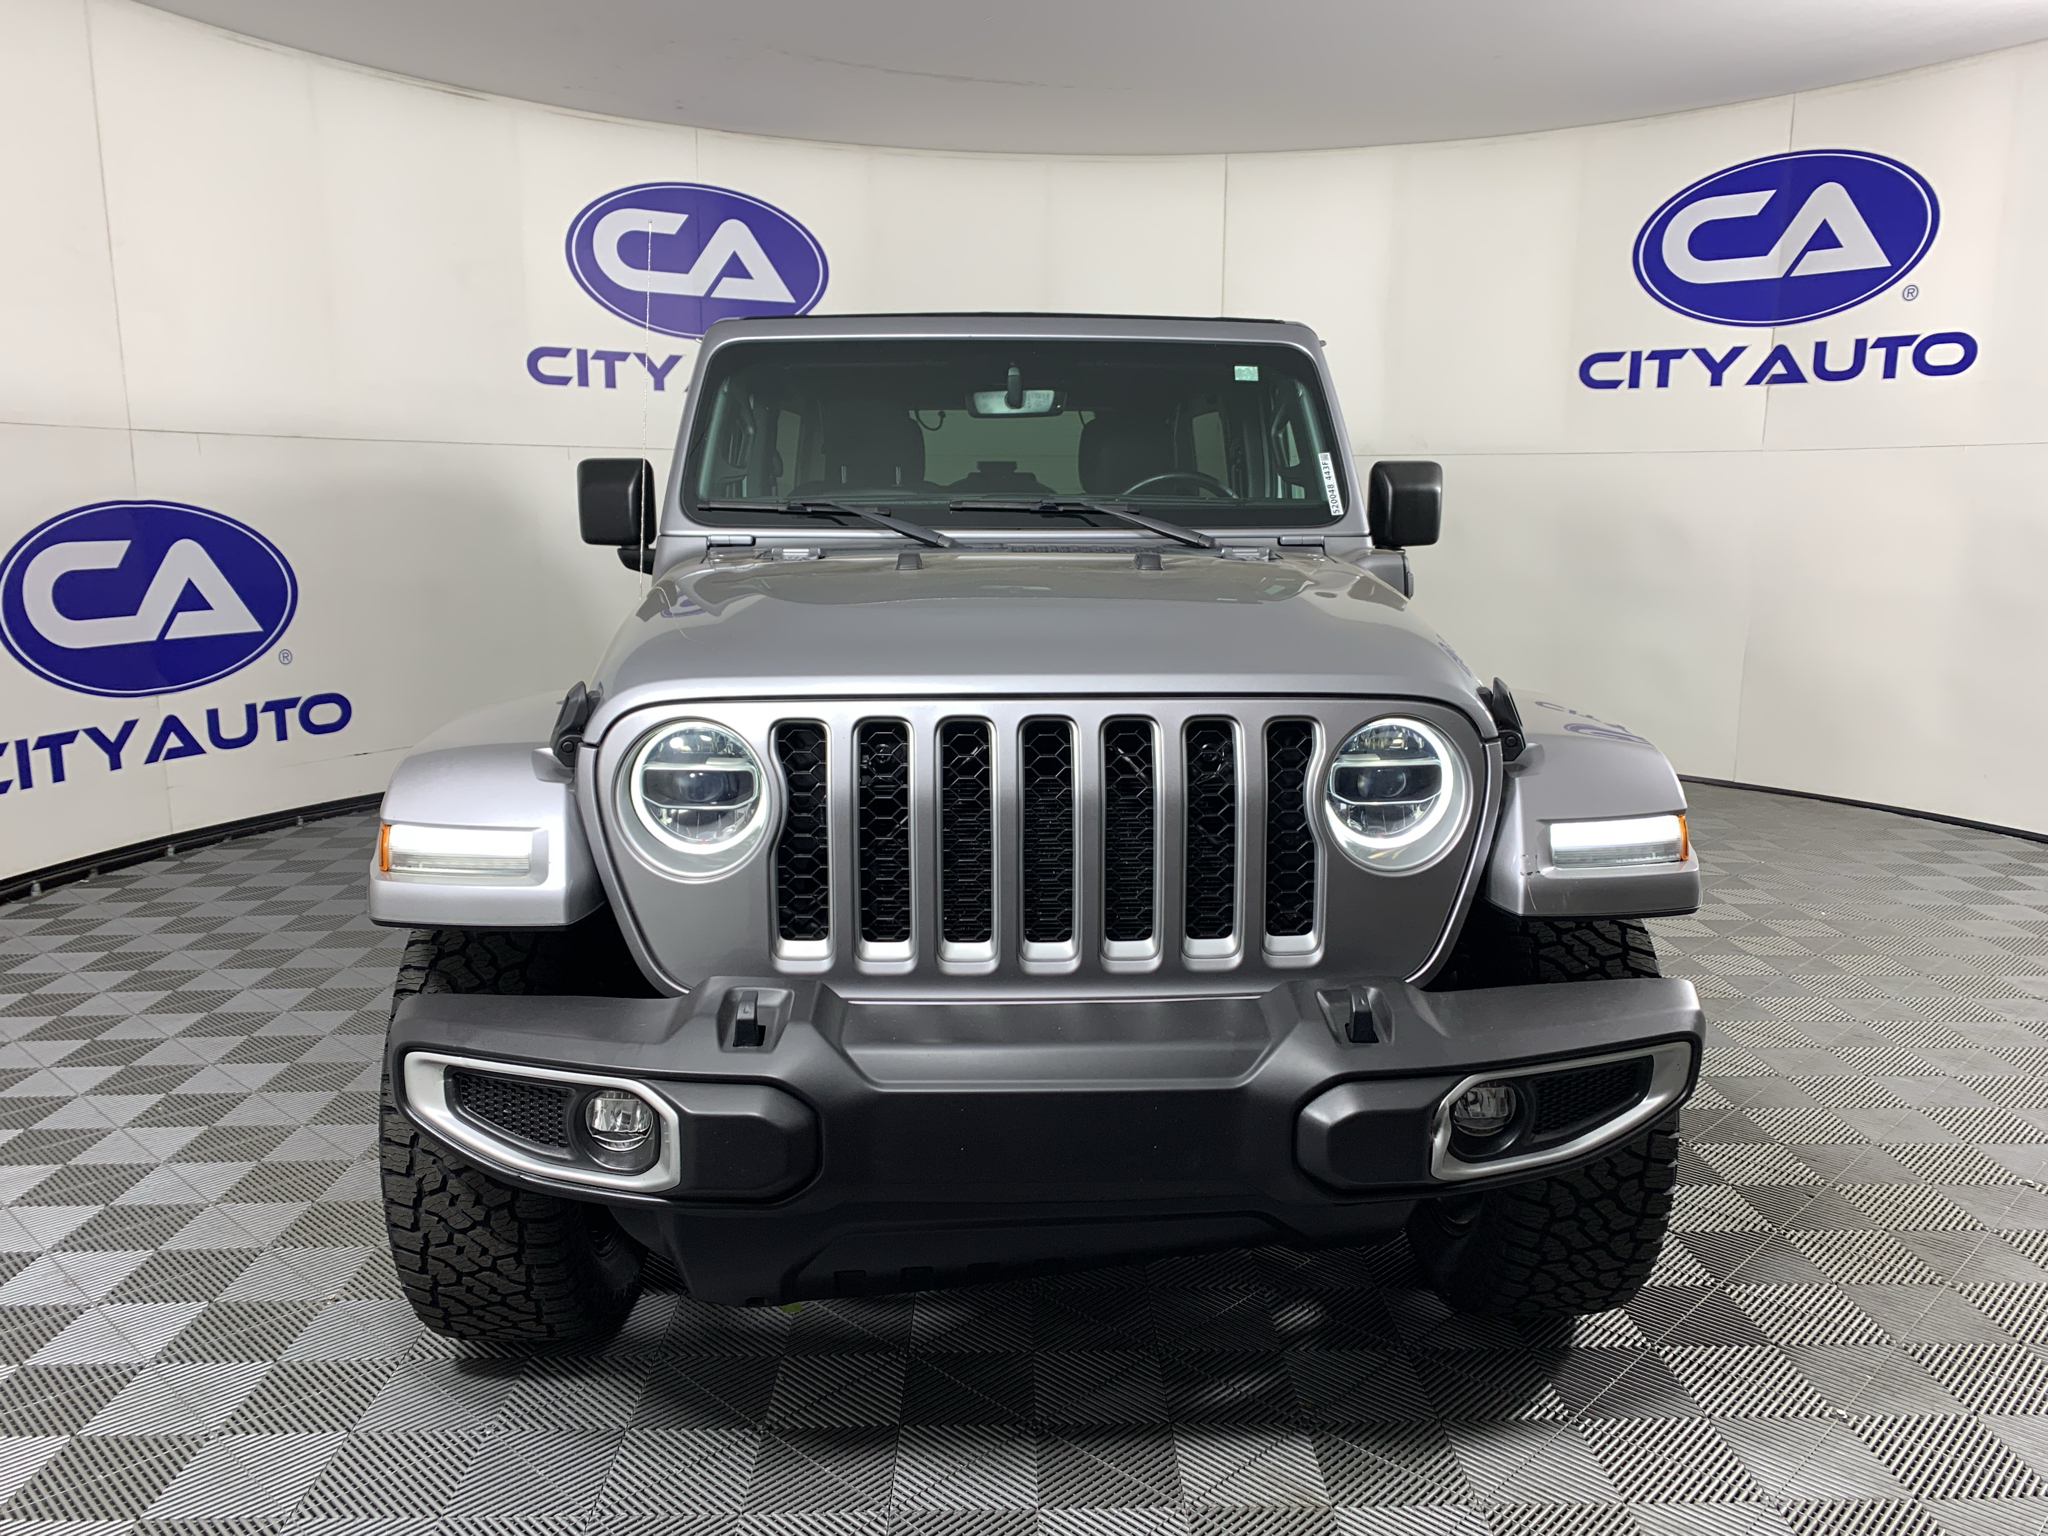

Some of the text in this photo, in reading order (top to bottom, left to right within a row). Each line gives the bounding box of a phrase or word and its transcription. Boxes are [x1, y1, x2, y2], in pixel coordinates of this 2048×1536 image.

[592, 206, 796, 303] CA
[1661, 181, 1892, 285] CA
[526, 346, 684, 392] CITY
[22, 538, 263, 649] CA
[0, 718, 139, 795] ITY
